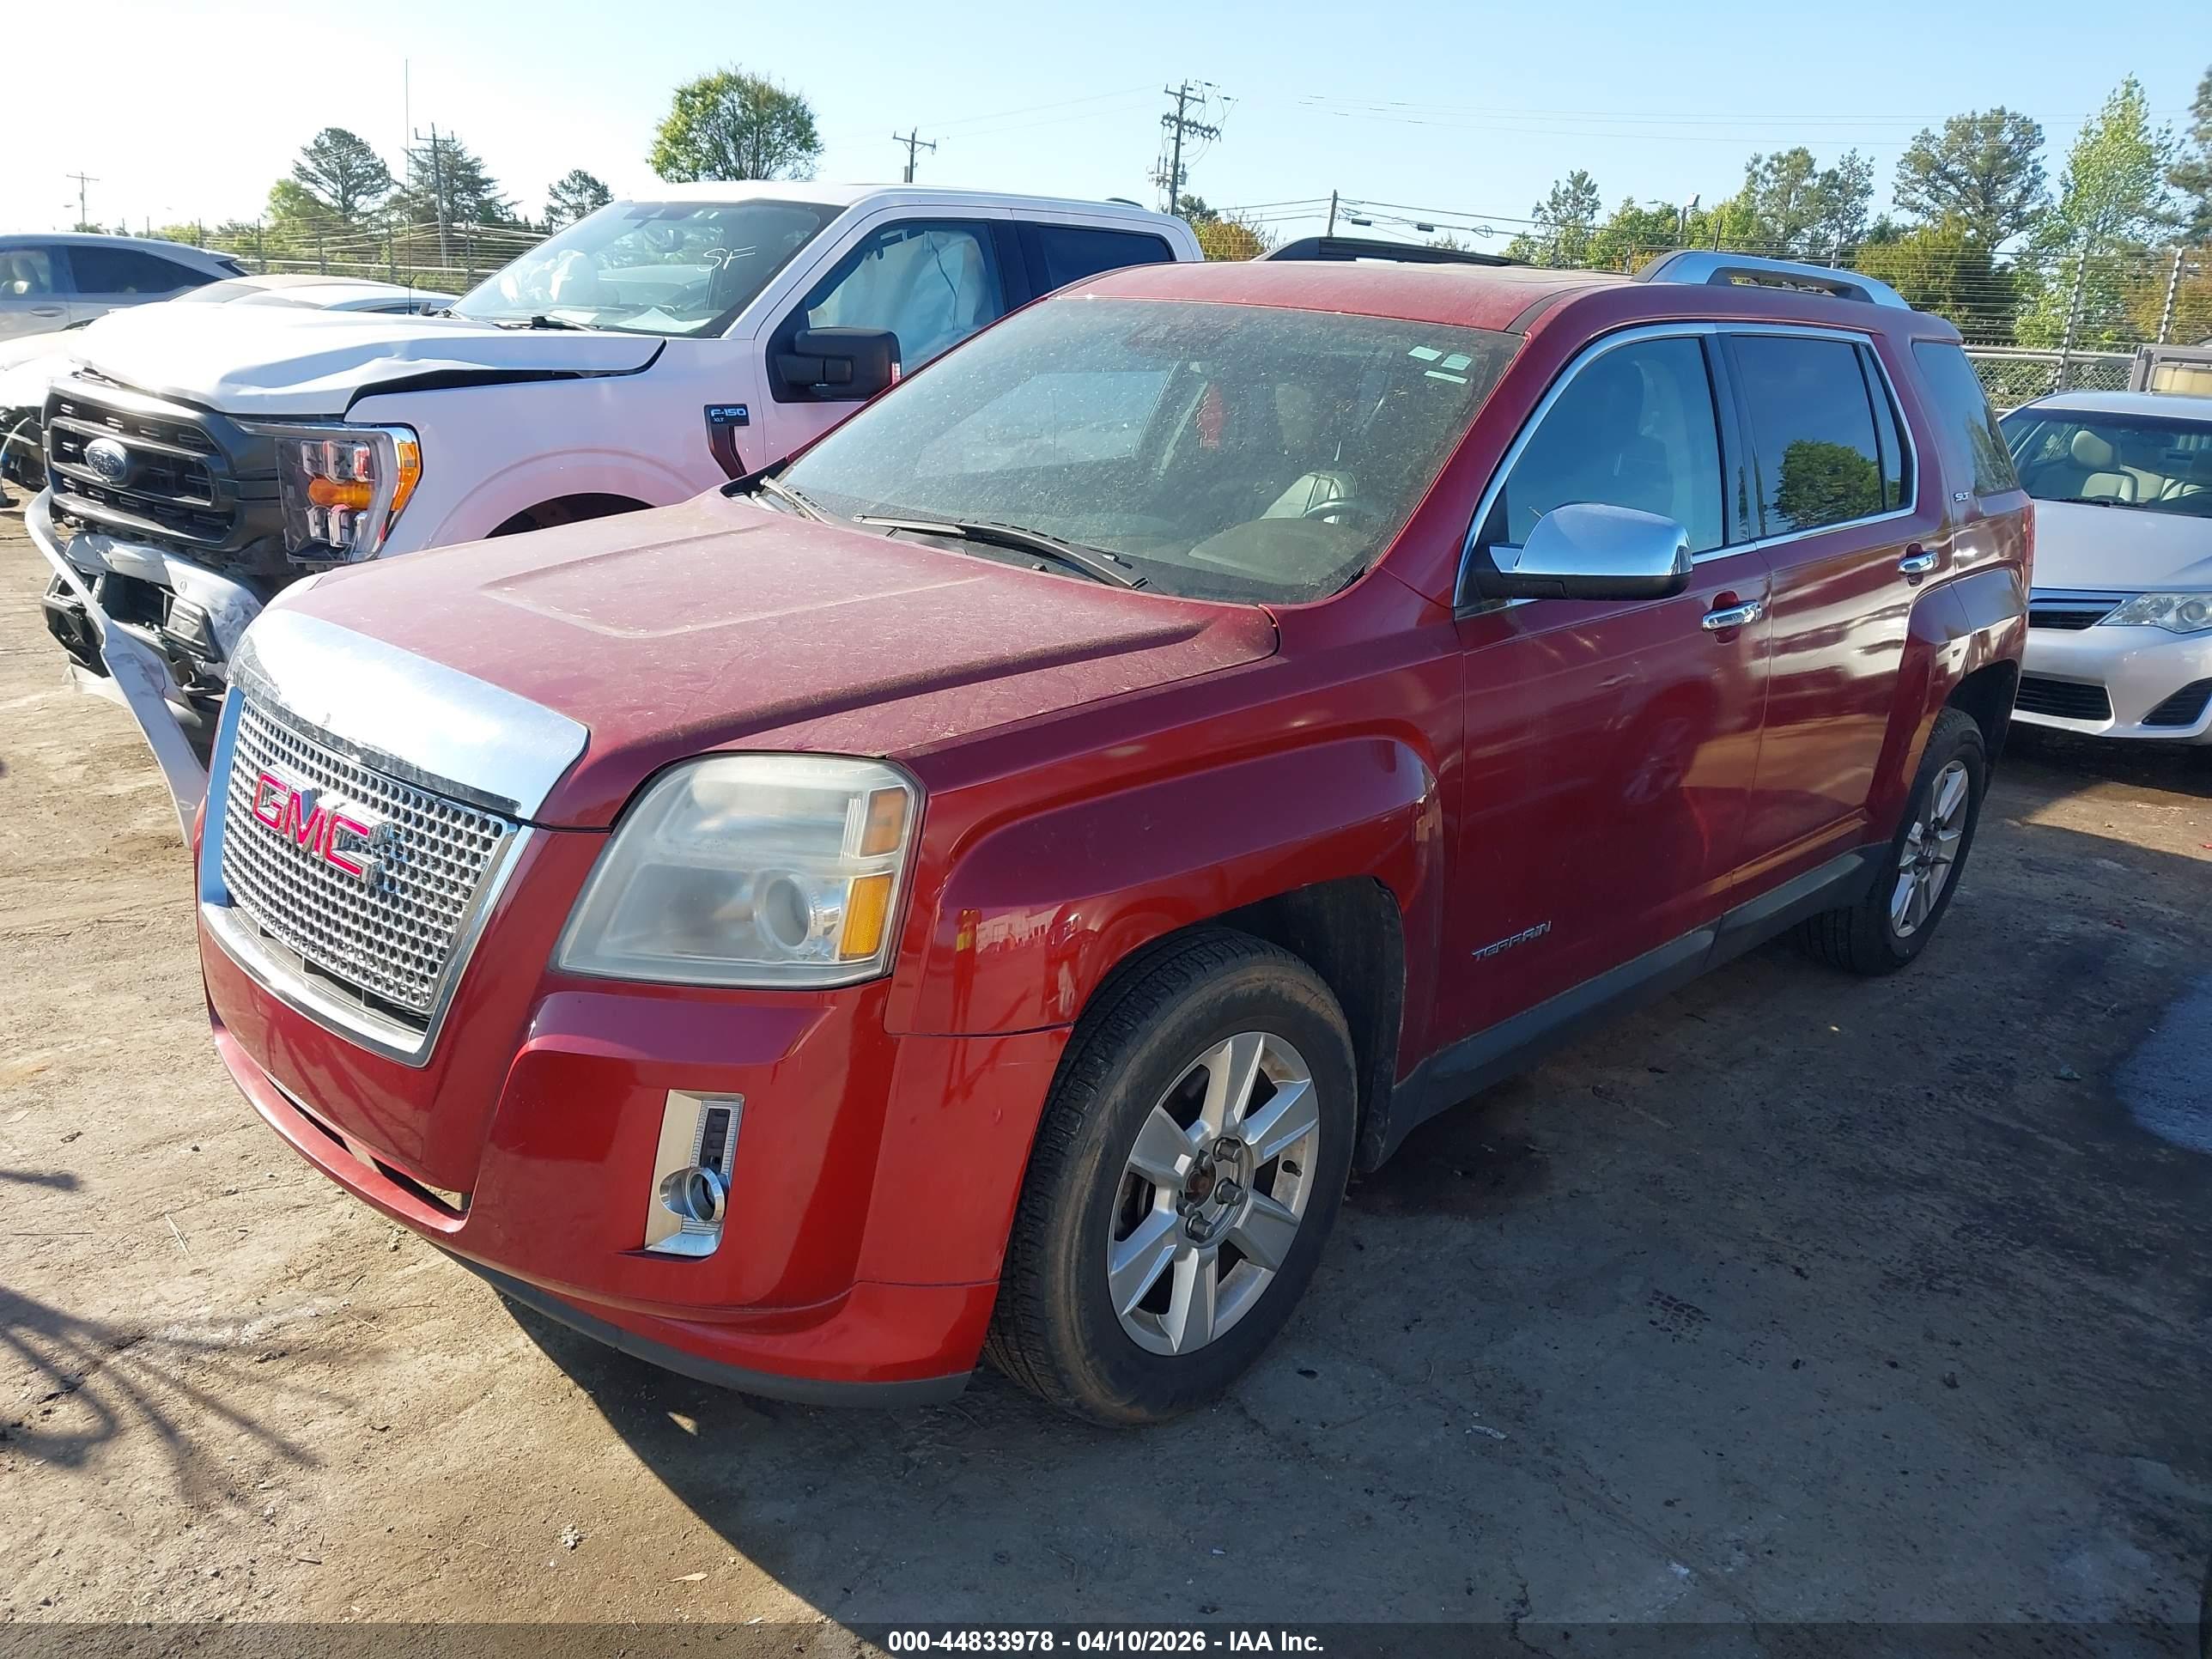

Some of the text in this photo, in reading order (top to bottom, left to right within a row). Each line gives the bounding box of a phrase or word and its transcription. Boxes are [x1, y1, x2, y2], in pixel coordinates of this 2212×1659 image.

[696, 246, 757, 272] SF
[710, 408, 747, 417] F-150
[252, 770, 376, 883] GMC
[1471, 920, 1552, 962] TERRAIN
